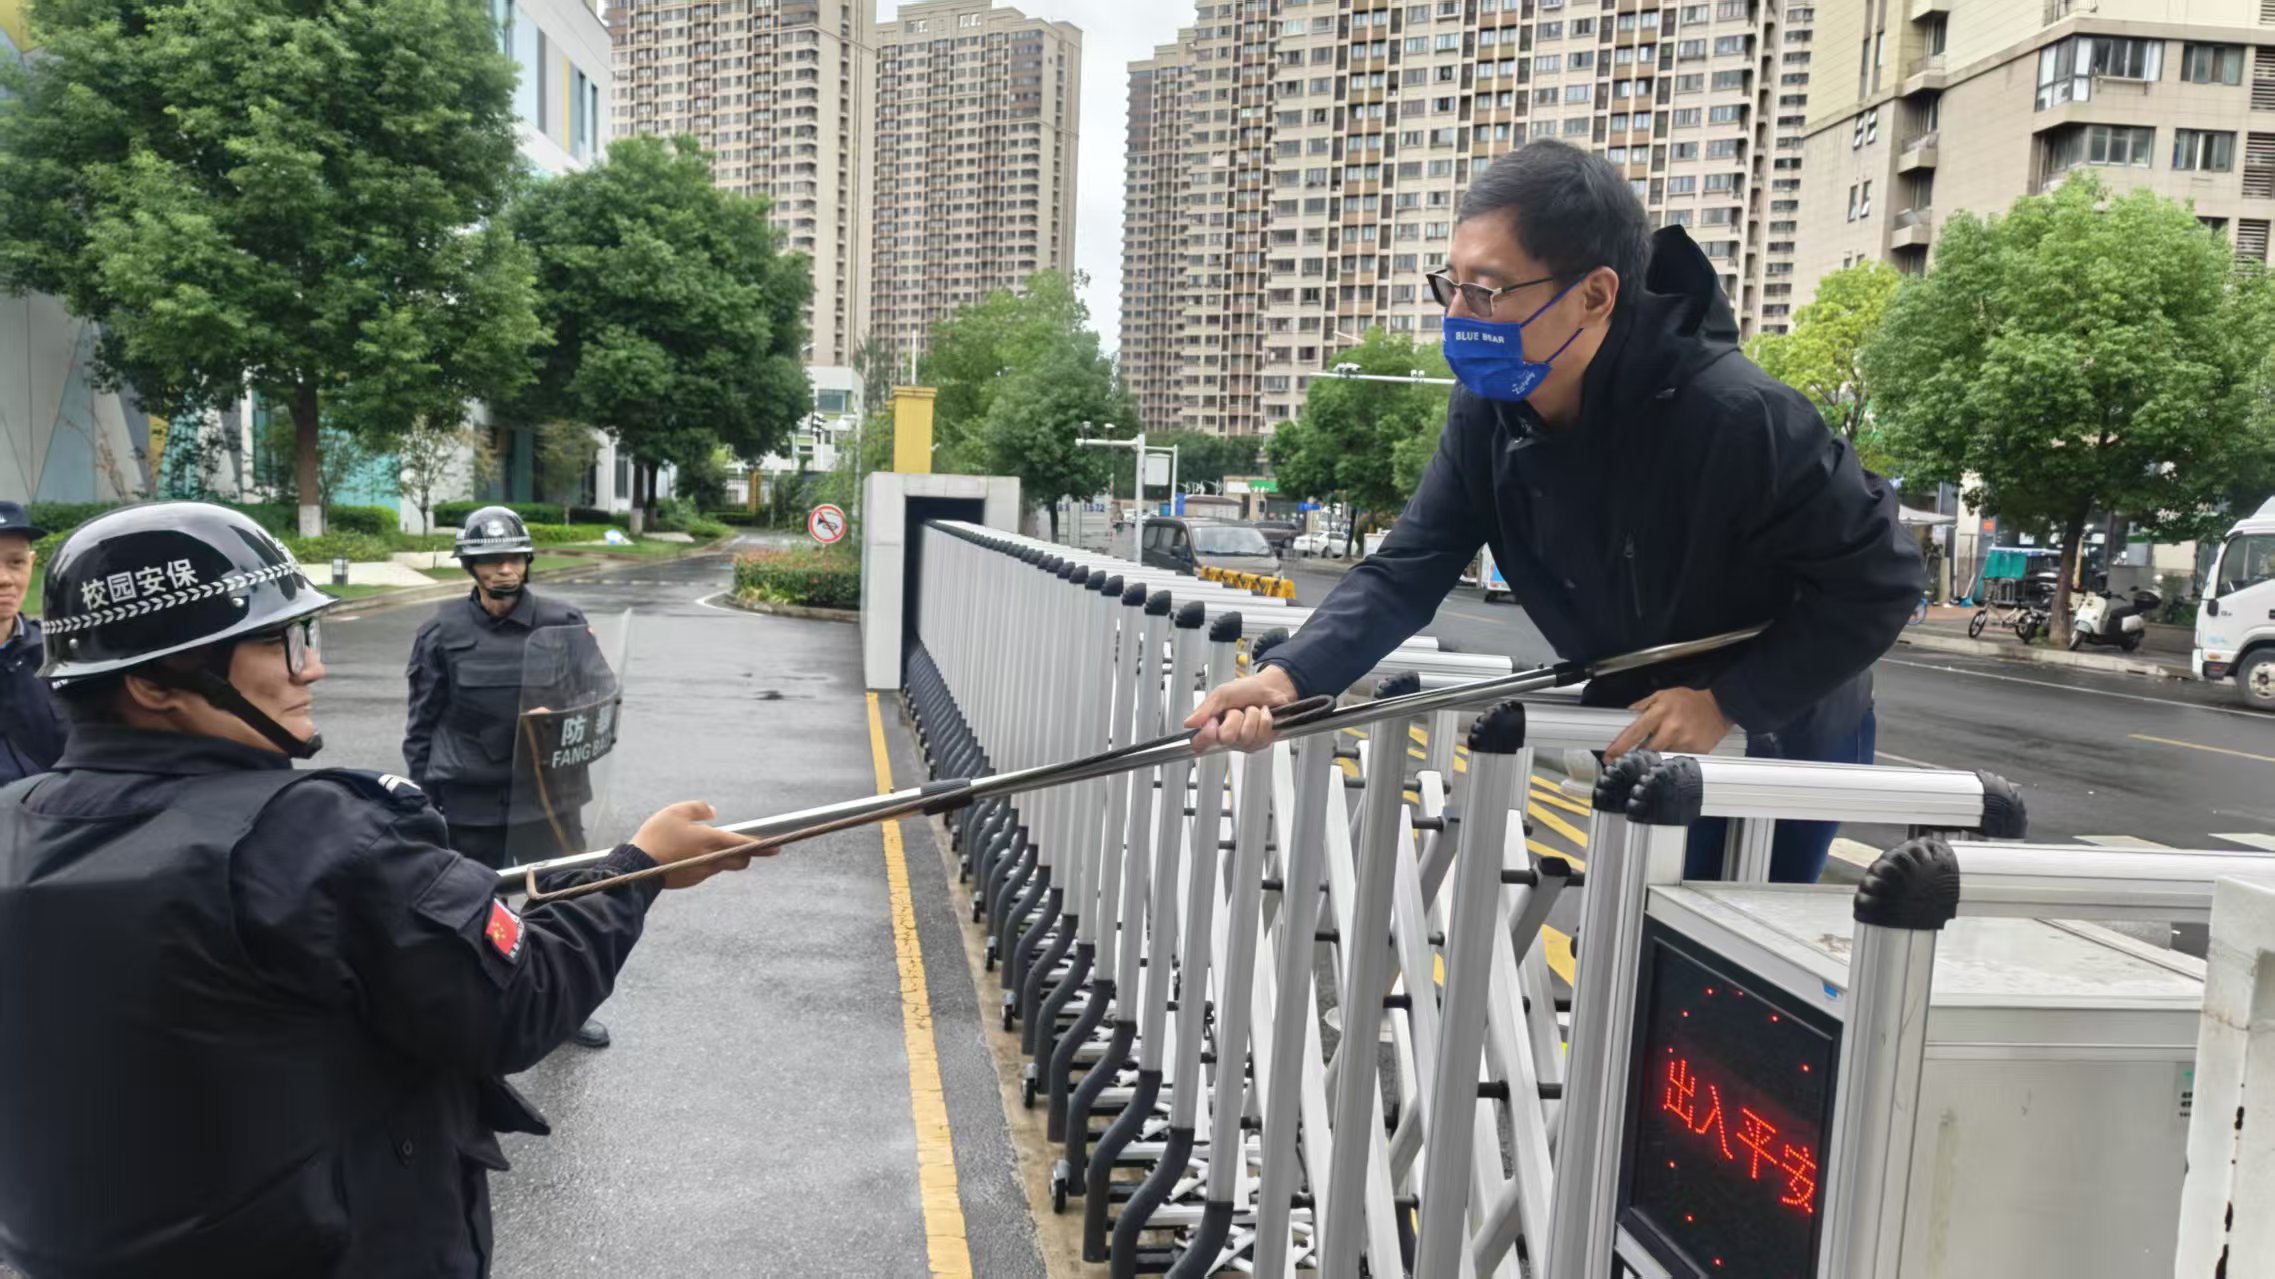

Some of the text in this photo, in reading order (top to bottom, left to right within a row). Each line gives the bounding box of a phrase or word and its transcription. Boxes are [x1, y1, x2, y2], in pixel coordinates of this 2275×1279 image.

[1455, 331, 1480, 341] BLUE
[80, 558, 200, 611] 校园安保
[552, 743, 592, 768] FANG
[1663, 1060, 1817, 1214] 出入平安
